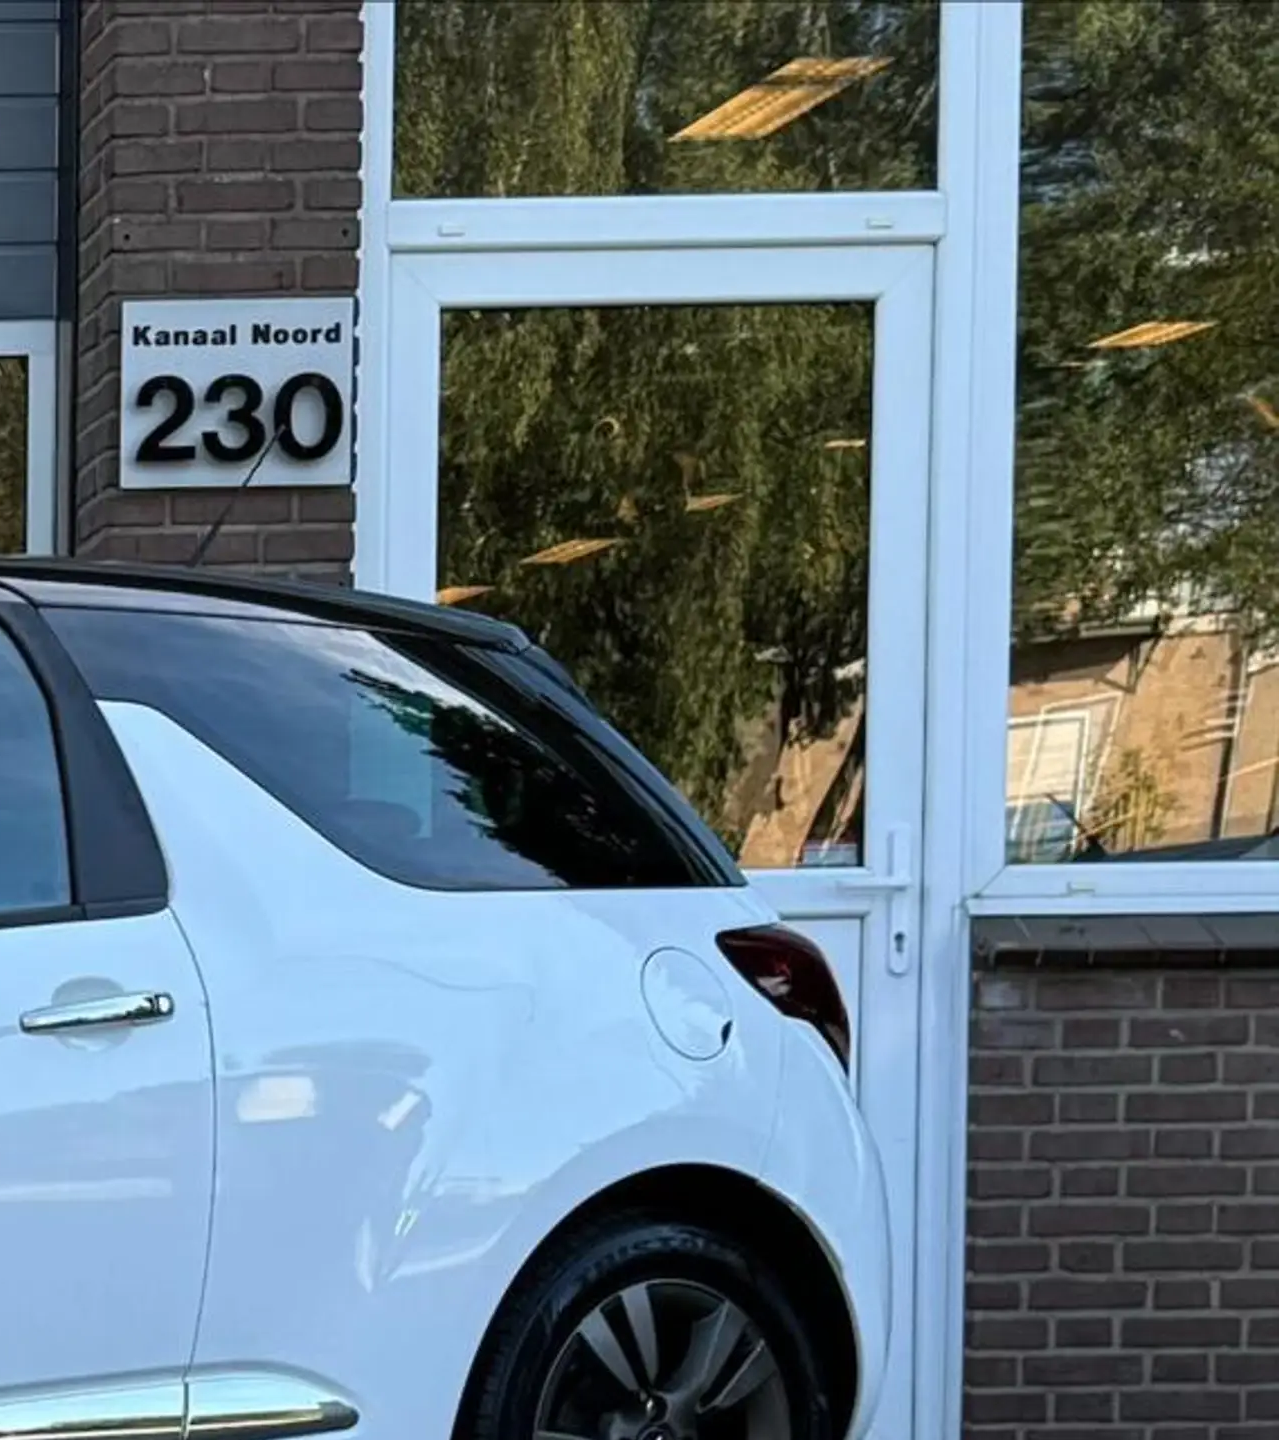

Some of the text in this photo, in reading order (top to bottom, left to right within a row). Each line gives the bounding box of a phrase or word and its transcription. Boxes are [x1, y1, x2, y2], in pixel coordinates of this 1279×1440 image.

[132, 322, 342, 346] Kanaal Noord
[135, 372, 344, 462] 230
